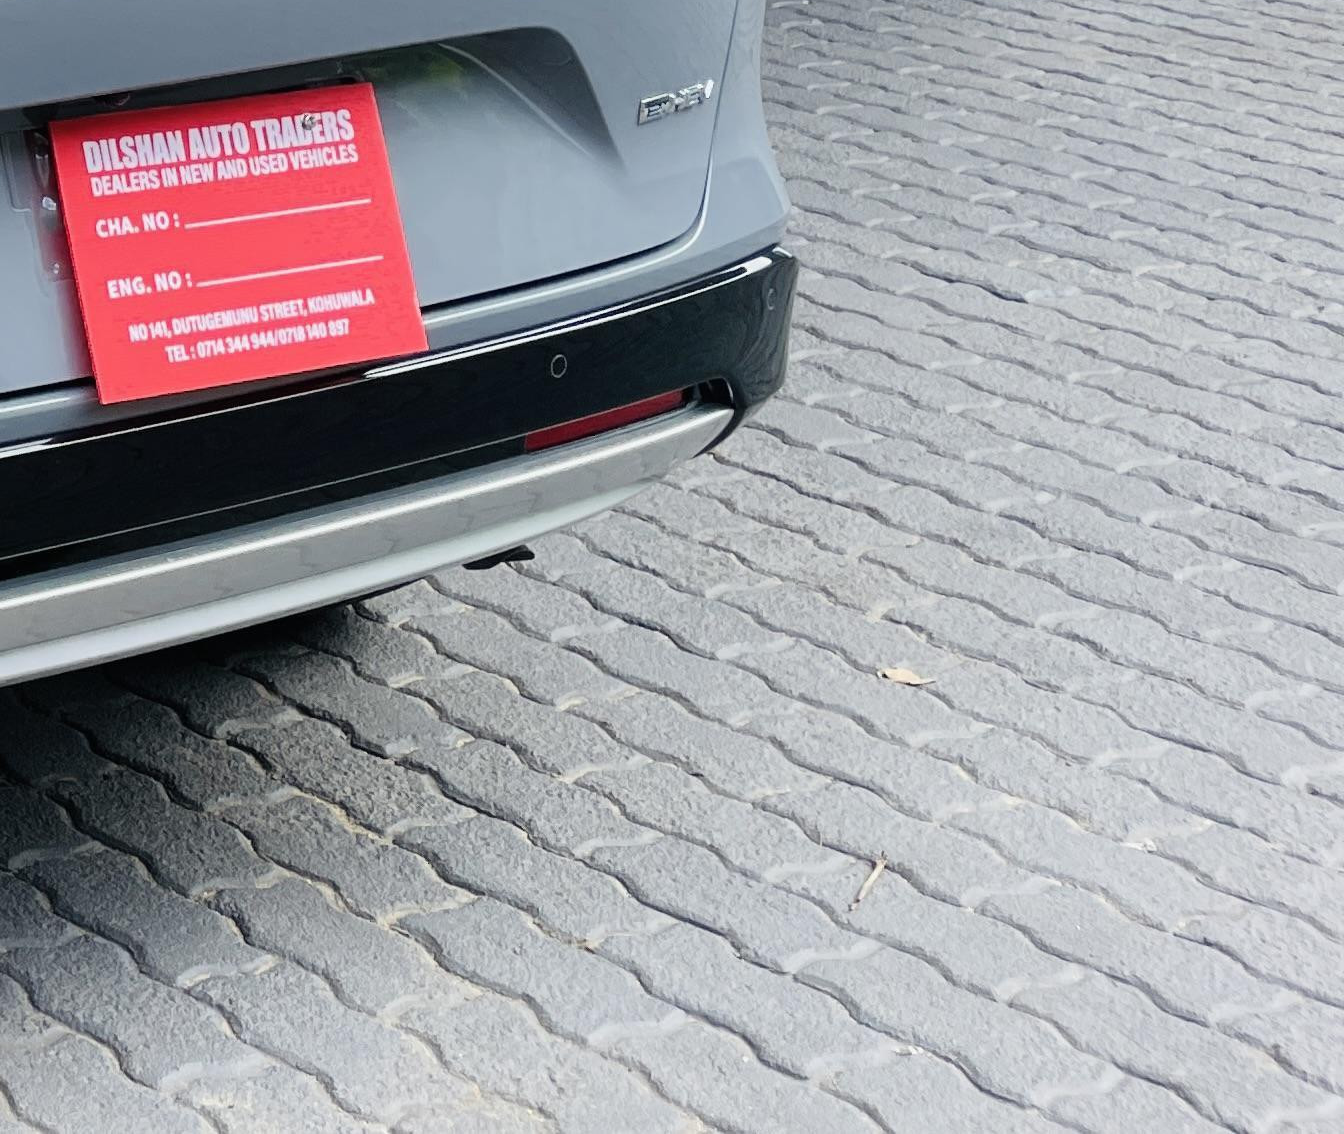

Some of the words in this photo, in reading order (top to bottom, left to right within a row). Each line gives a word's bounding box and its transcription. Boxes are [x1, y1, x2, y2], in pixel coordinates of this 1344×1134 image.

[82, 130, 187, 174] DILSHAN
[188, 121, 251, 161] AUTO
[251, 108, 356, 153] TRADERS
[90, 169, 161, 198] DEALERS
[160, 167, 180, 188] IN
[180, 163, 214, 186] NEW
[216, 158, 248, 181] AND
[250, 152, 289, 178] USED
[291, 143, 360, 172] VEHICLES
[95, 215, 140, 239] CHA.
[106, 275, 153, 300] ENG.
[128, 323, 149, 343] NO
[172, 305, 259, 335] DUTUGEMUNU
[260, 299, 308, 322] STREET,
[308, 288, 376, 314] KOHUWALA
[197, 339, 226, 359] 0714
[227, 335, 251, 355] 344
[306, 322, 327, 341] 140
[328, 318, 350, 337] 897
